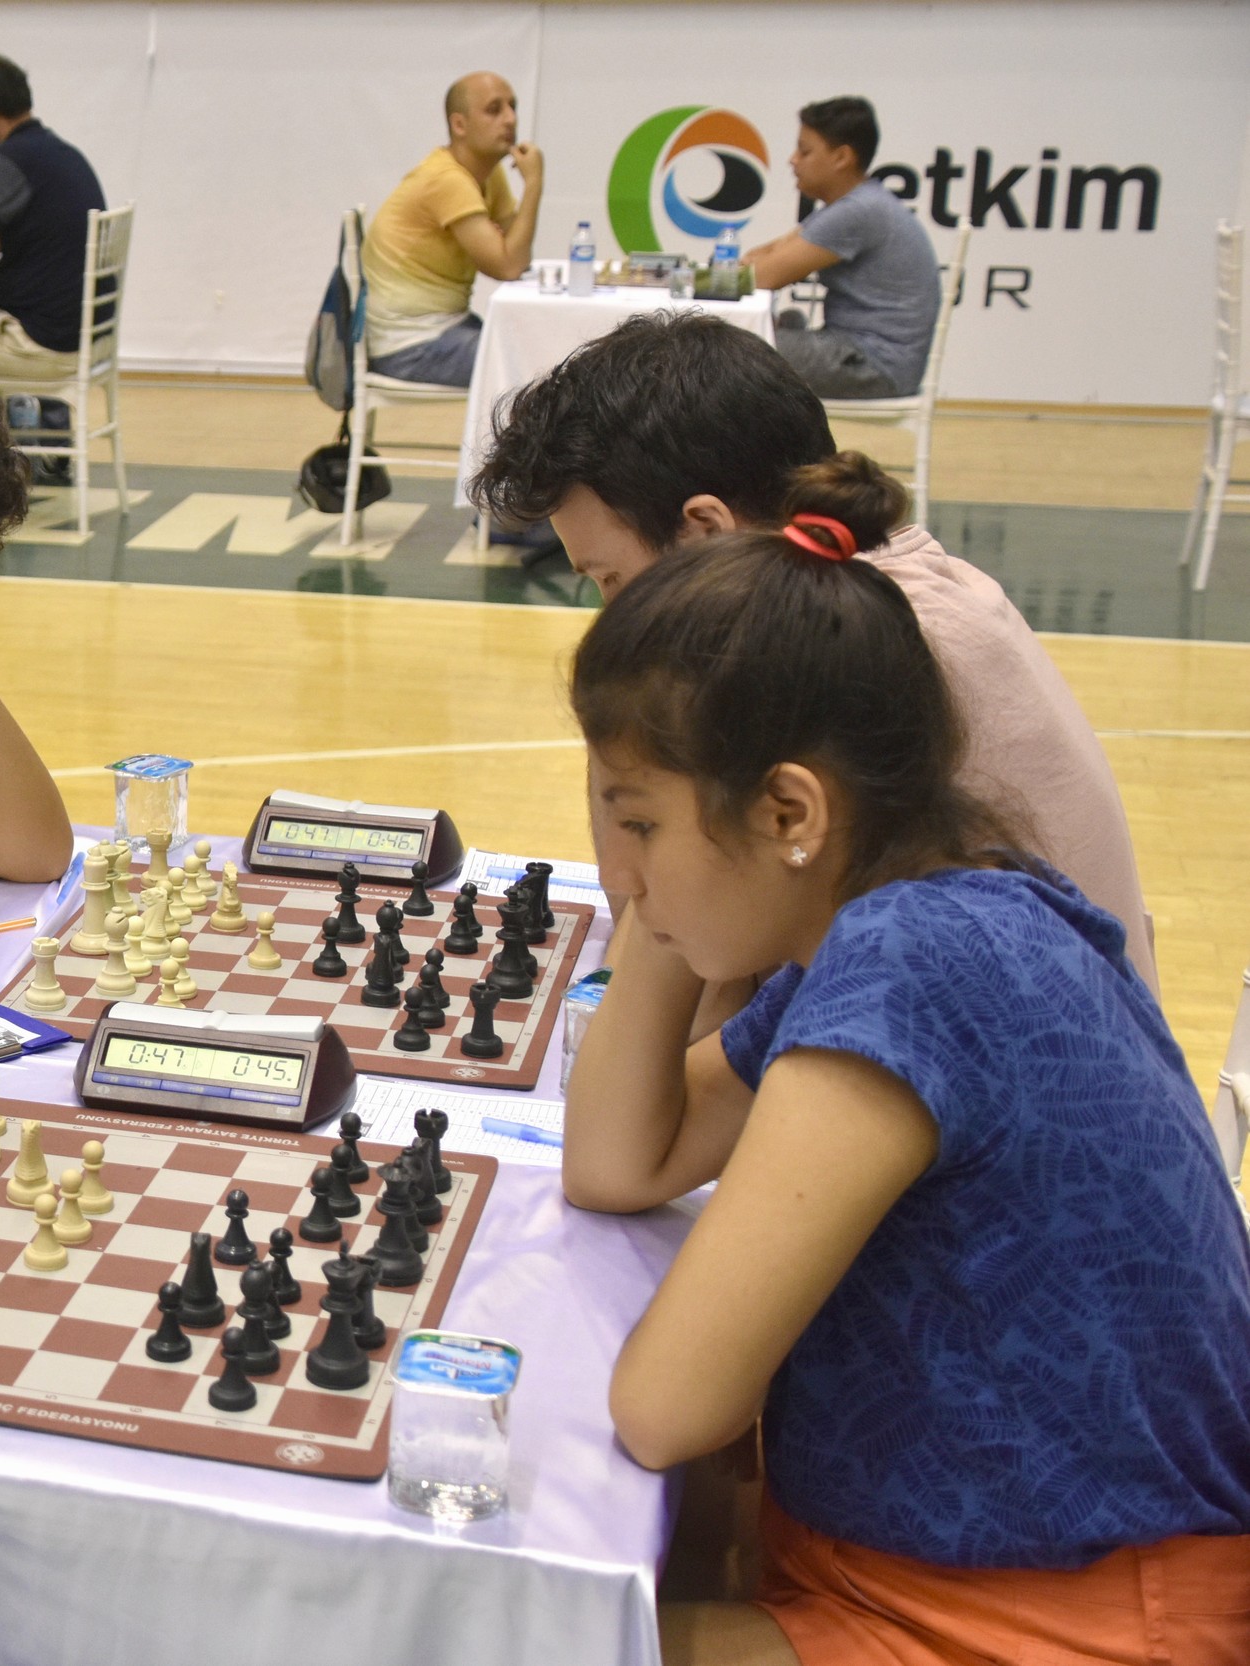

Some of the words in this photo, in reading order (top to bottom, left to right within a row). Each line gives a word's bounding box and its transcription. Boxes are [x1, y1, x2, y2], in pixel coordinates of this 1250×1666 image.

[798, 146, 1161, 231] etkim
[75, 1113, 173, 1131] FEDERASYONU
[175, 1121, 241, 1139] SATRANÇ
[16, 1405, 139, 1433] FEDERASYONU
